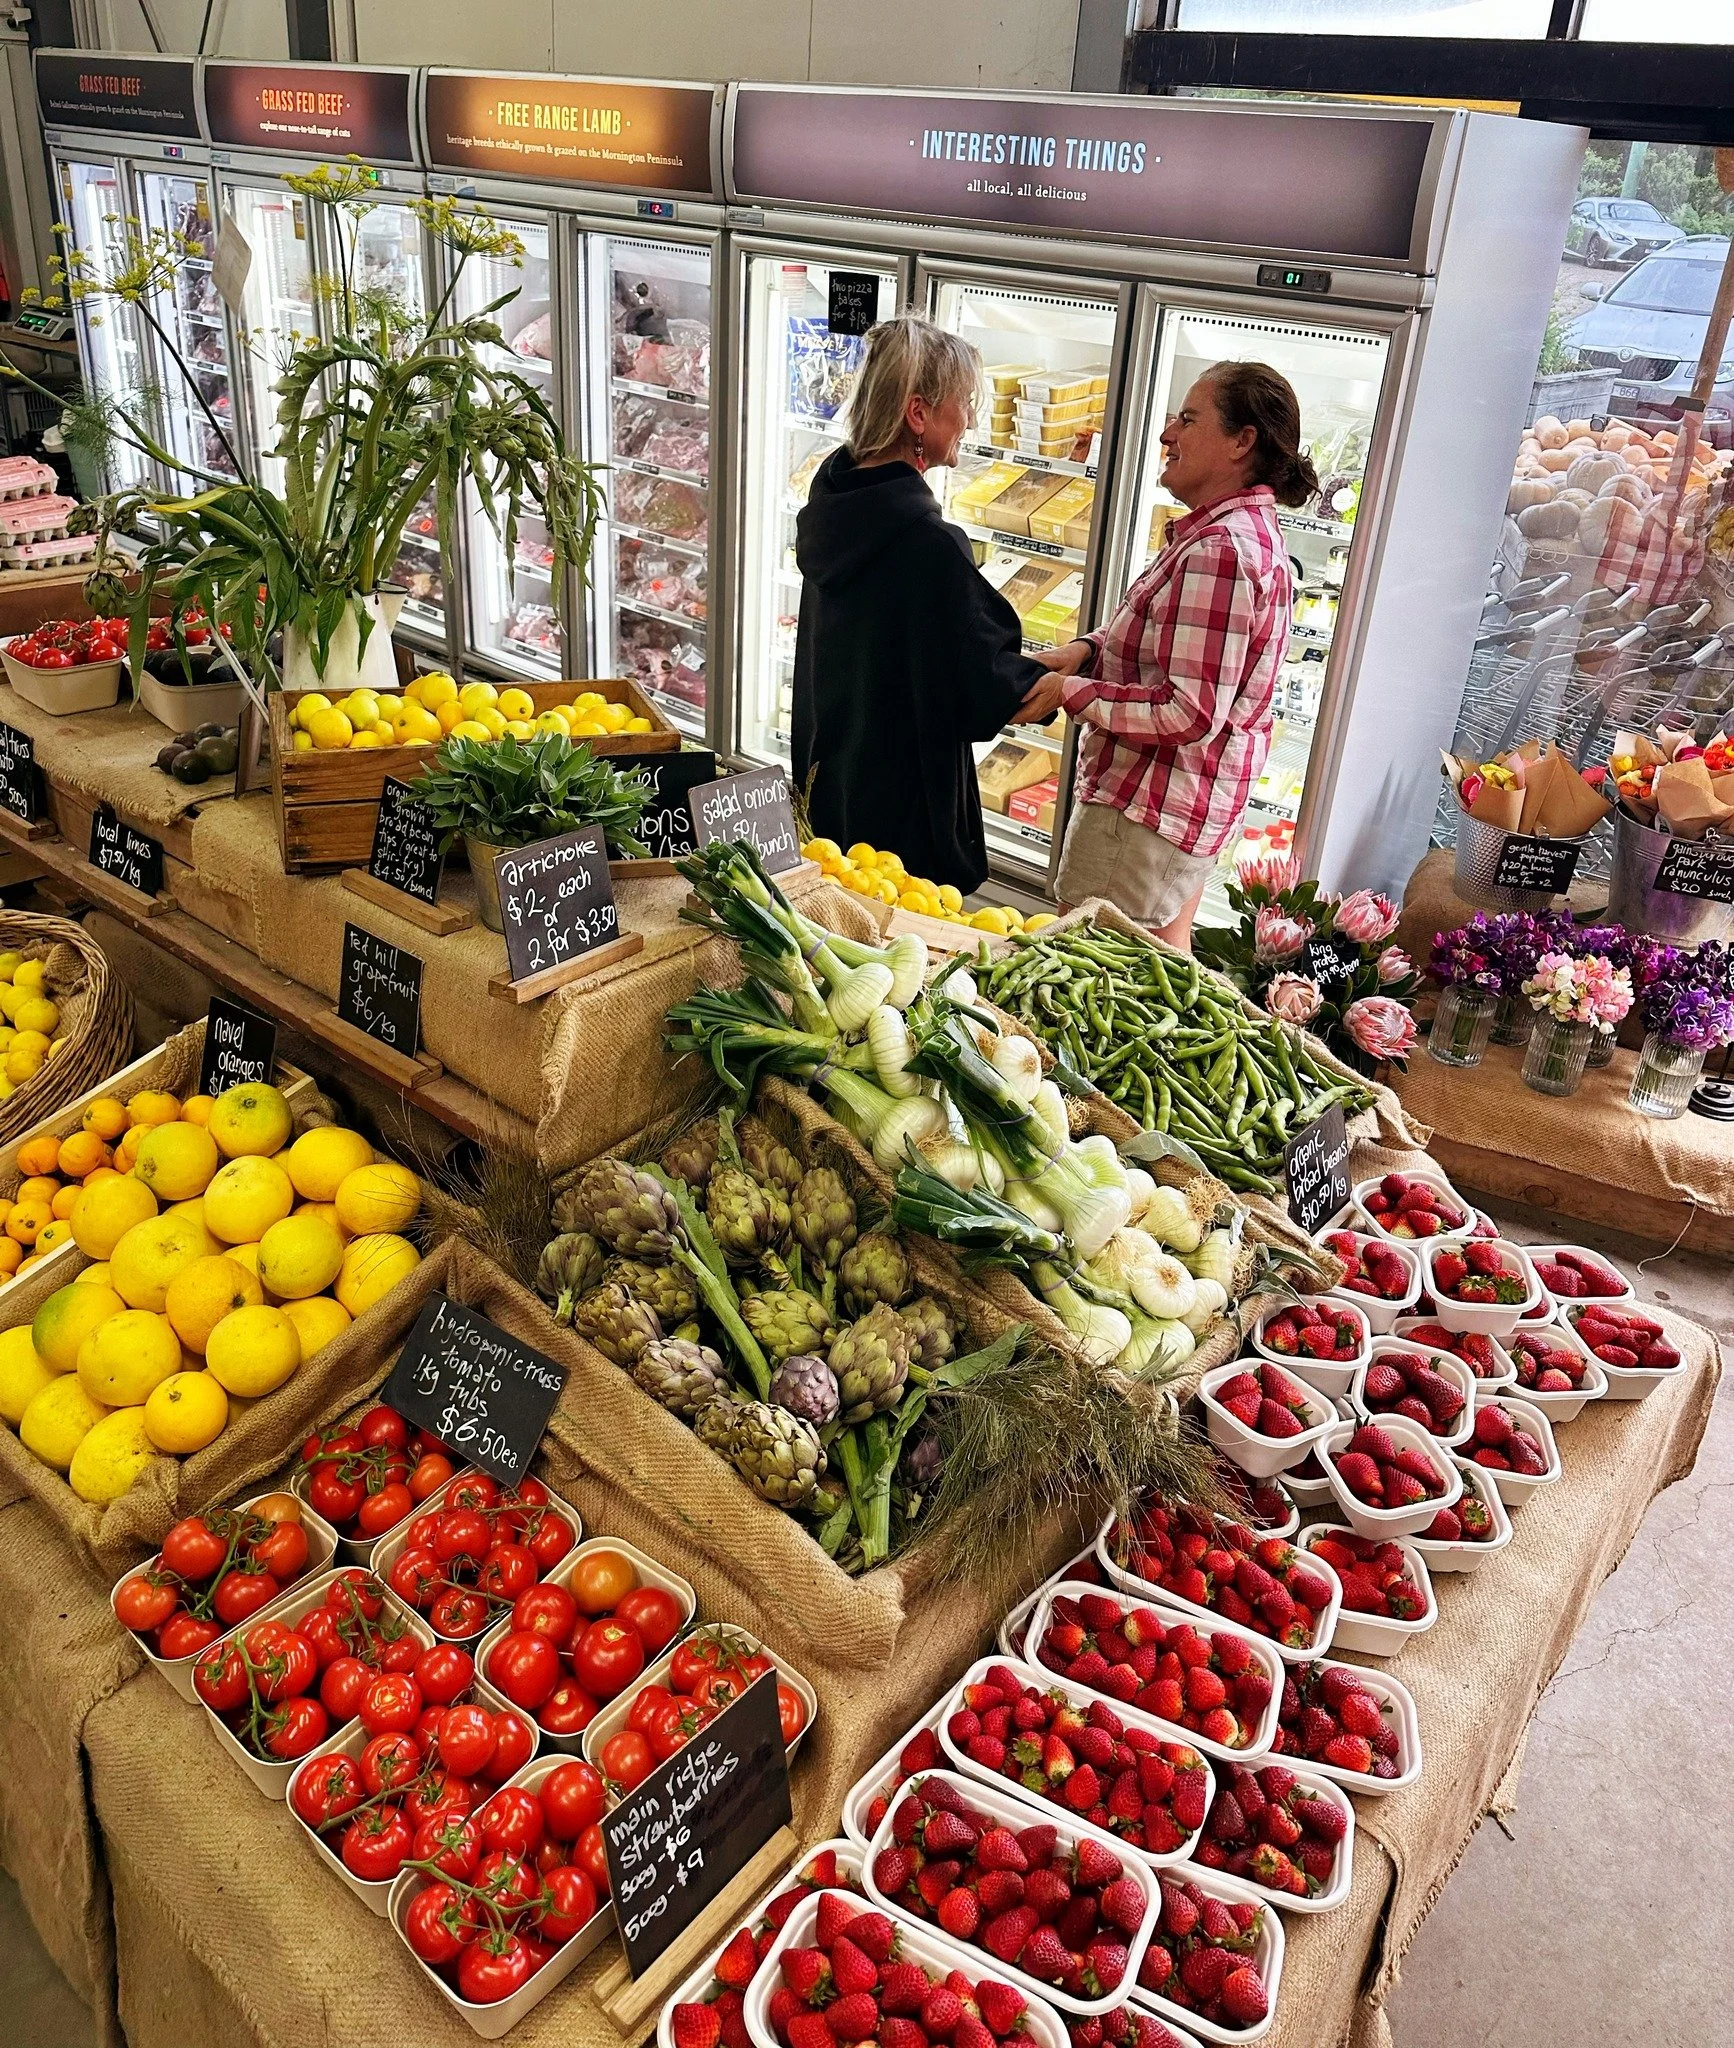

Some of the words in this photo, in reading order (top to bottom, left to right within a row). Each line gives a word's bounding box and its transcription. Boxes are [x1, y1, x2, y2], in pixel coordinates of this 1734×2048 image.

[79, 74, 103, 93] GRASS
[105, 76, 119, 94] FED
[121, 77, 141, 97] BEEF
[262, 88, 294, 112] GRASS
[296, 91, 315, 114] FED
[317, 93, 344, 116] BEEF
[497, 101, 530, 128] FREE
[533, 104, 579, 132] RANGE
[583, 108, 622, 136] LAMB
[446, 133, 473, 148] heritage
[473, 136, 495, 148] breeds
[495, 138, 524, 153] ethically
[524, 143, 546, 155] grown
[546, 143, 554, 154] &
[554, 145, 577, 158] grazed
[578, 148, 588, 157] on
[588, 147, 601, 159] the
[601, 149, 646, 164] Mornington
[646, 153, 684, 167] Peninsula
[922, 129, 1057, 168] INTERESTING
[1065, 137, 1148, 174] THINGS
[966, 179, 982, 193] all
[984, 181, 1014, 197] local,
[1017, 183, 1033, 197] all
[1035, 186, 1088, 202] delicious
[832, 278, 846, 293] two
[847, 282, 873, 300] pizza
[838, 293, 862, 307] bases
[832, 304, 846, 322] for
[9, 731, 30, 758] truss
[393, 805, 425, 826] grown
[702, 783, 743, 826] salad
[744, 779, 788, 810] onions
[97, 816, 119, 843] local
[126, 830, 152, 859] limes
[379, 827, 397, 853] tips
[429, 848, 438, 862] to
[1507, 843, 1535, 854] gentle
[1538, 846, 1573, 859] harvest
[501, 840, 599, 887] artichoke
[1501, 859, 1521, 870] $20
[1530, 862, 1555, 874] bunch
[1662, 863, 1733, 887] ranunculus
[558, 865, 592, 898] each
[1521, 876, 1535, 887] for
[1670, 877, 1701, 894] $20
[544, 901, 561, 927] or
[527, 938, 546, 970] 2
[547, 927, 570, 965] for
[574, 904, 616, 946] $3.50
[1308, 943, 1333, 958] king
[375, 944, 399, 971] hill
[348, 959, 419, 1002] grapefruit
[214, 1016, 245, 1051] navel
[218, 1050, 265, 1083] oranges
[1289, 1129, 1326, 1181] organic
[1292, 1156, 1322, 1204] broad
[1321, 1140, 1348, 1177] beans
[429, 1301, 523, 1373] hydroponic
[524, 1364, 563, 1392] truss
[441, 1345, 502, 1392] tomato
[449, 1379, 489, 1418] tubs
[610, 1796, 660, 1847] main
[666, 1741, 721, 1797] ridge
[620, 1862, 657, 1903] 300g
[624, 1894, 668, 1942] 500g
